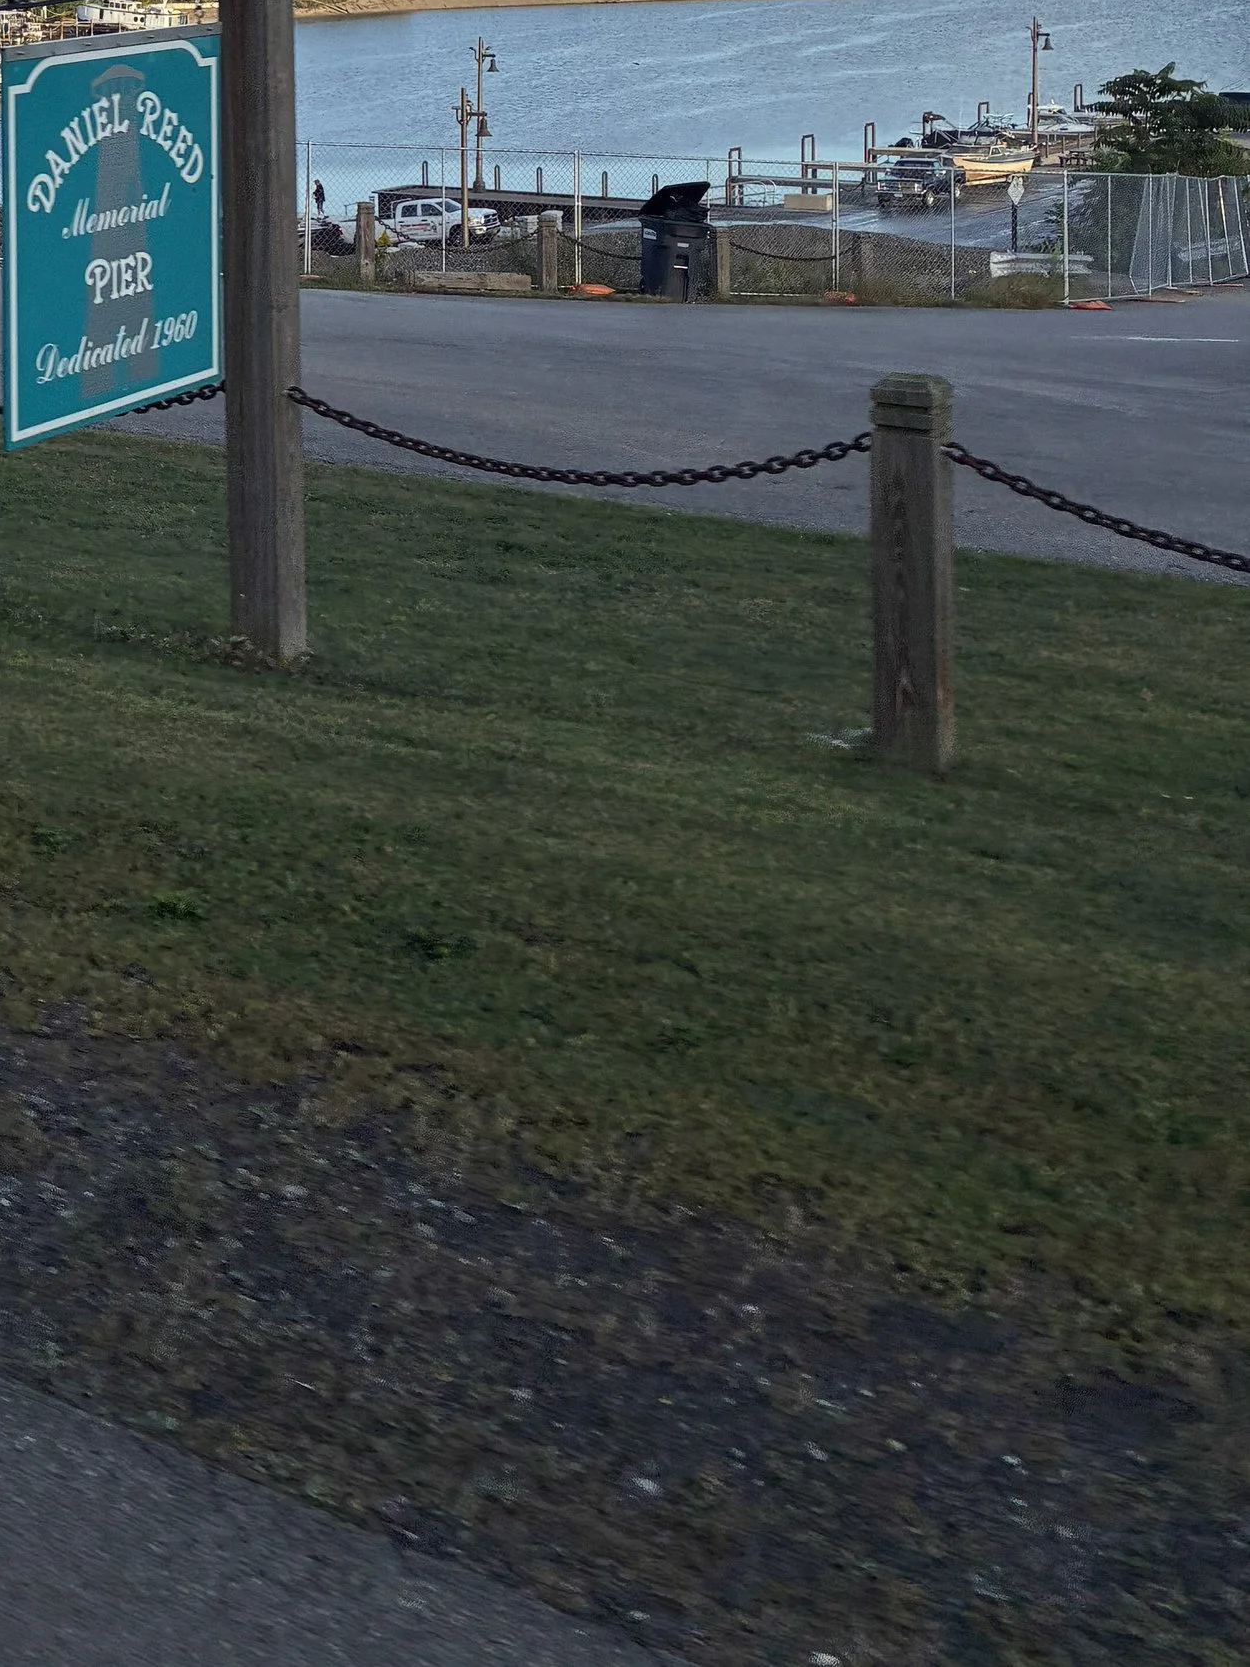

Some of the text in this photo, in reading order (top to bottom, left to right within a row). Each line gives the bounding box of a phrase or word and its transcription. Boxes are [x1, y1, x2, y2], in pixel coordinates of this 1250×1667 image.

[27, 91, 204, 213] DANIEL REED
[62, 182, 171, 239] Memorial
[85, 252, 154, 304] PIER
[37, 310, 198, 384] Dedicated 1960
